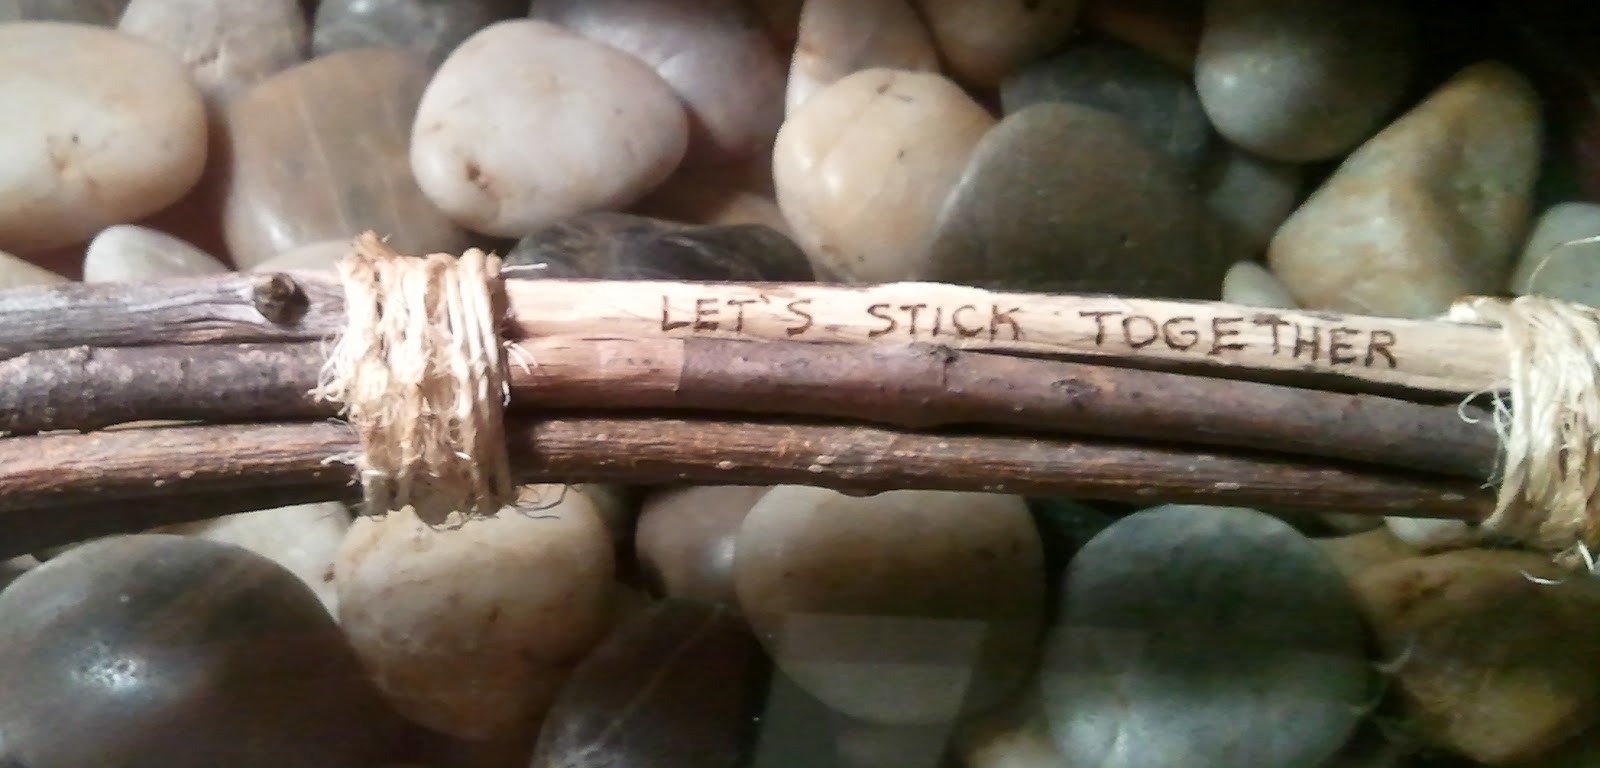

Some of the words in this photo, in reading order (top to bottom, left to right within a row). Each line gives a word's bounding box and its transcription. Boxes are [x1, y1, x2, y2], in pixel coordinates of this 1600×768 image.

[662, 294, 813, 337] LET'S
[866, 302, 1022, 342] STICK
[1078, 310, 1398, 370] TOGETHER
